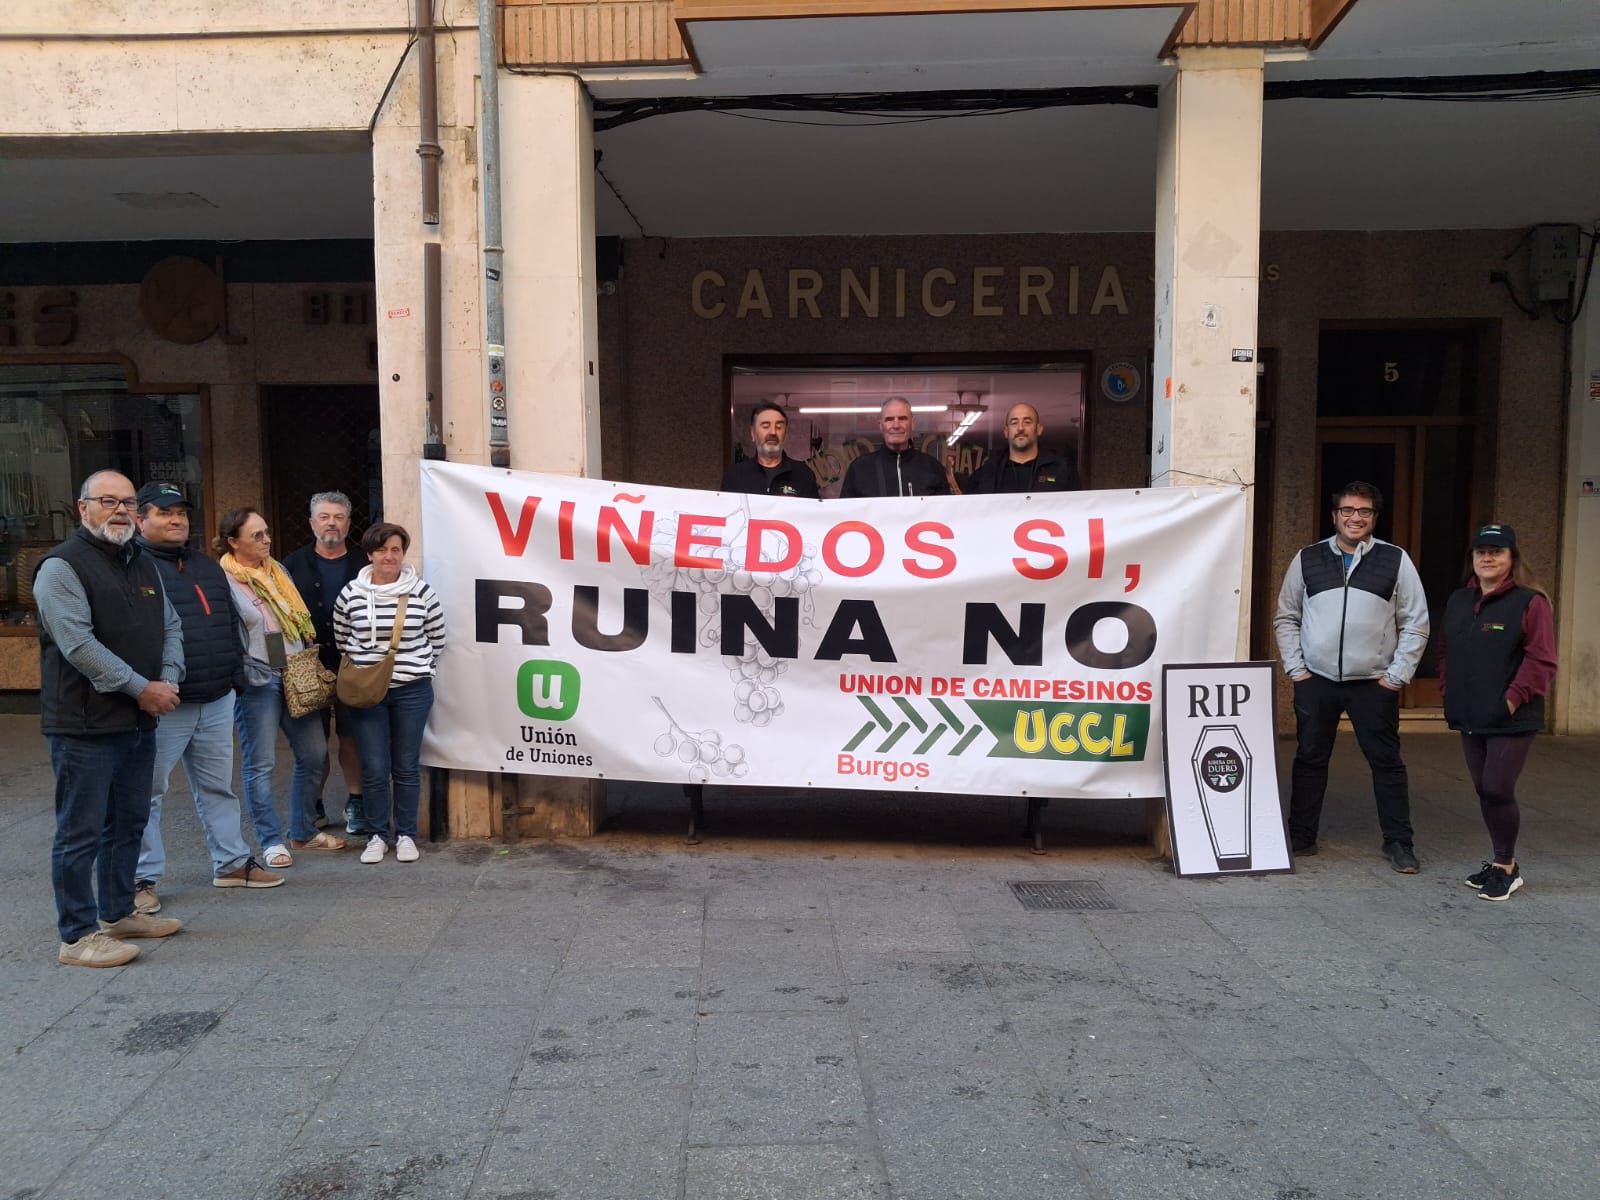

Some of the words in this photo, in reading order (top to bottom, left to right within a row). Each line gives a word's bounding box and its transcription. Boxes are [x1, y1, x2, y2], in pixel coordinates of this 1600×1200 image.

[691, 265, 1128, 319] CARNICERIA
[1383, 362, 1399, 382] 5
[486, 492, 957, 579] VIÑEDOS
[1012, 518, 1141, 593] SI,
[475, 579, 898, 662] RUINA
[963, 601, 1157, 669] NO
[839, 674, 922, 696] UNION
[931, 677, 966, 697] DE
[973, 678, 1153, 702] CAMPESINOS
[1188, 683, 1251, 718] RIP
[520, 725, 578, 747] Unión
[1013, 709, 1135, 758] UCCL
[506, 746, 524, 762] de
[529, 747, 593, 767] Uniones
[837, 754, 930, 782] Burgos
[1208, 765, 1237, 773] DUERO
